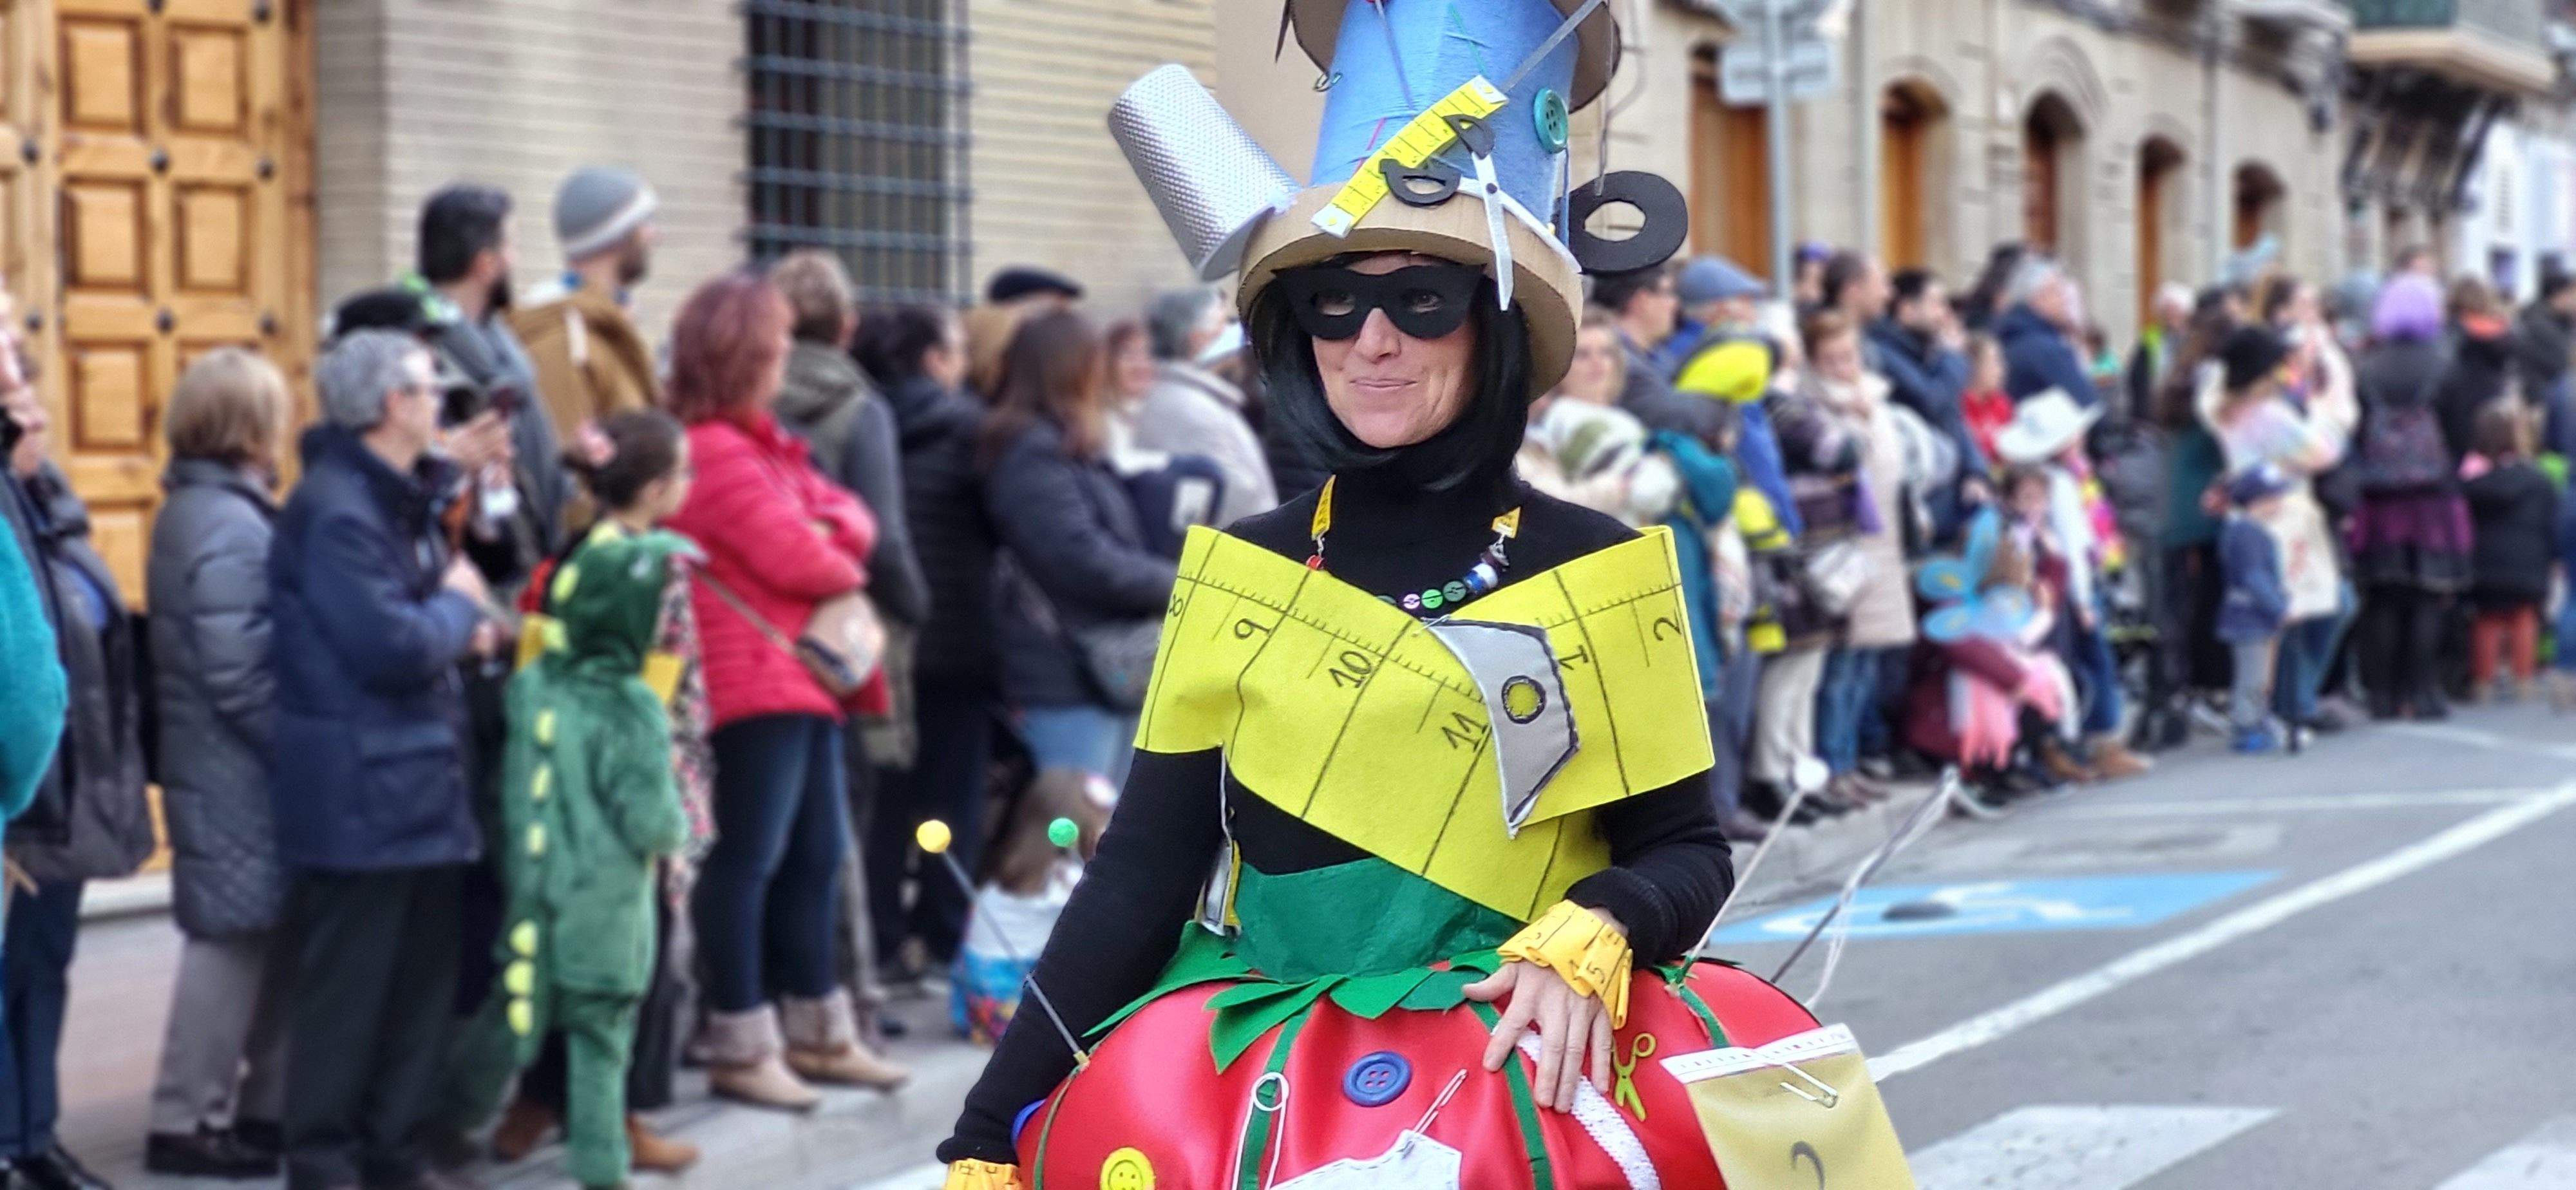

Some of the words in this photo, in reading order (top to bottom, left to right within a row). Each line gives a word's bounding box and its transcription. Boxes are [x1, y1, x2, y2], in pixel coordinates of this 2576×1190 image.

[1233, 618, 1273, 639] 9
[1329, 650, 1376, 690] 10
[1440, 712, 1490, 753] 11
[1558, 644, 1589, 671] 1
[1652, 607, 1683, 642] 2
